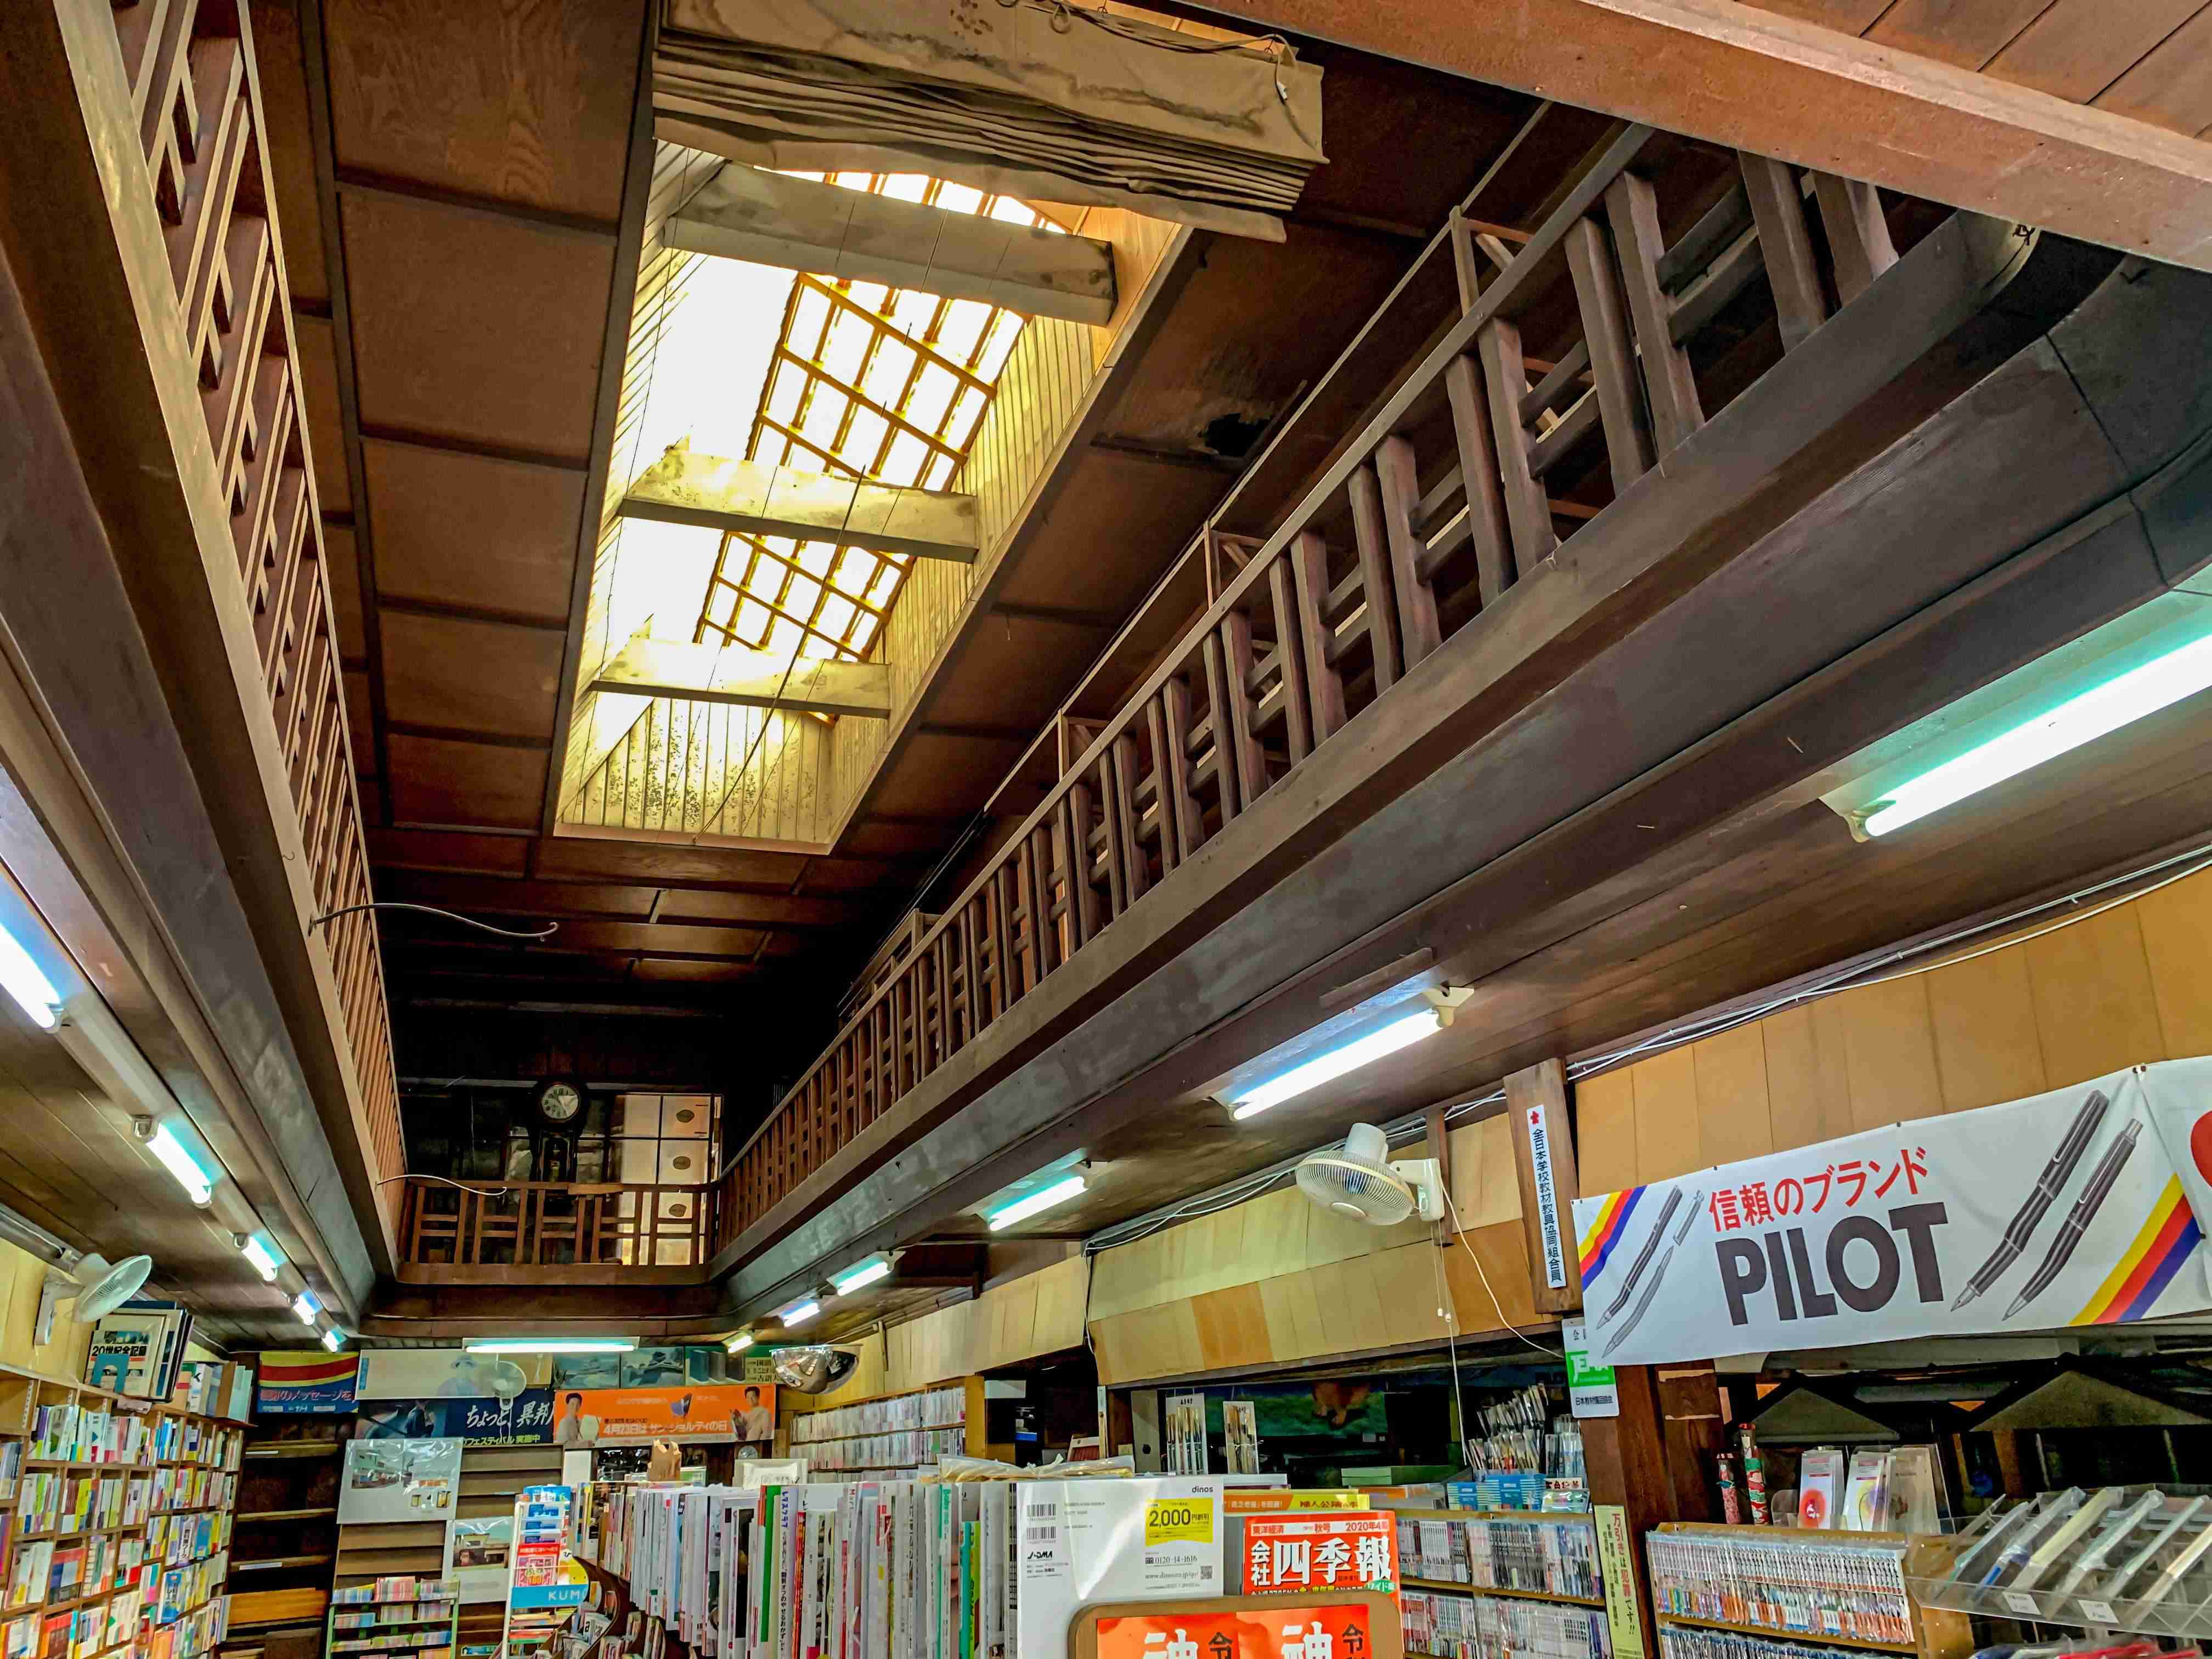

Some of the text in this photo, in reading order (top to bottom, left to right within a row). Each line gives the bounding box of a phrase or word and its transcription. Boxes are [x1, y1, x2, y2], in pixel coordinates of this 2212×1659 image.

[1709, 1146, 1928, 1232] 信頼のブランド
[1715, 1201, 1948, 1326] PILOT
